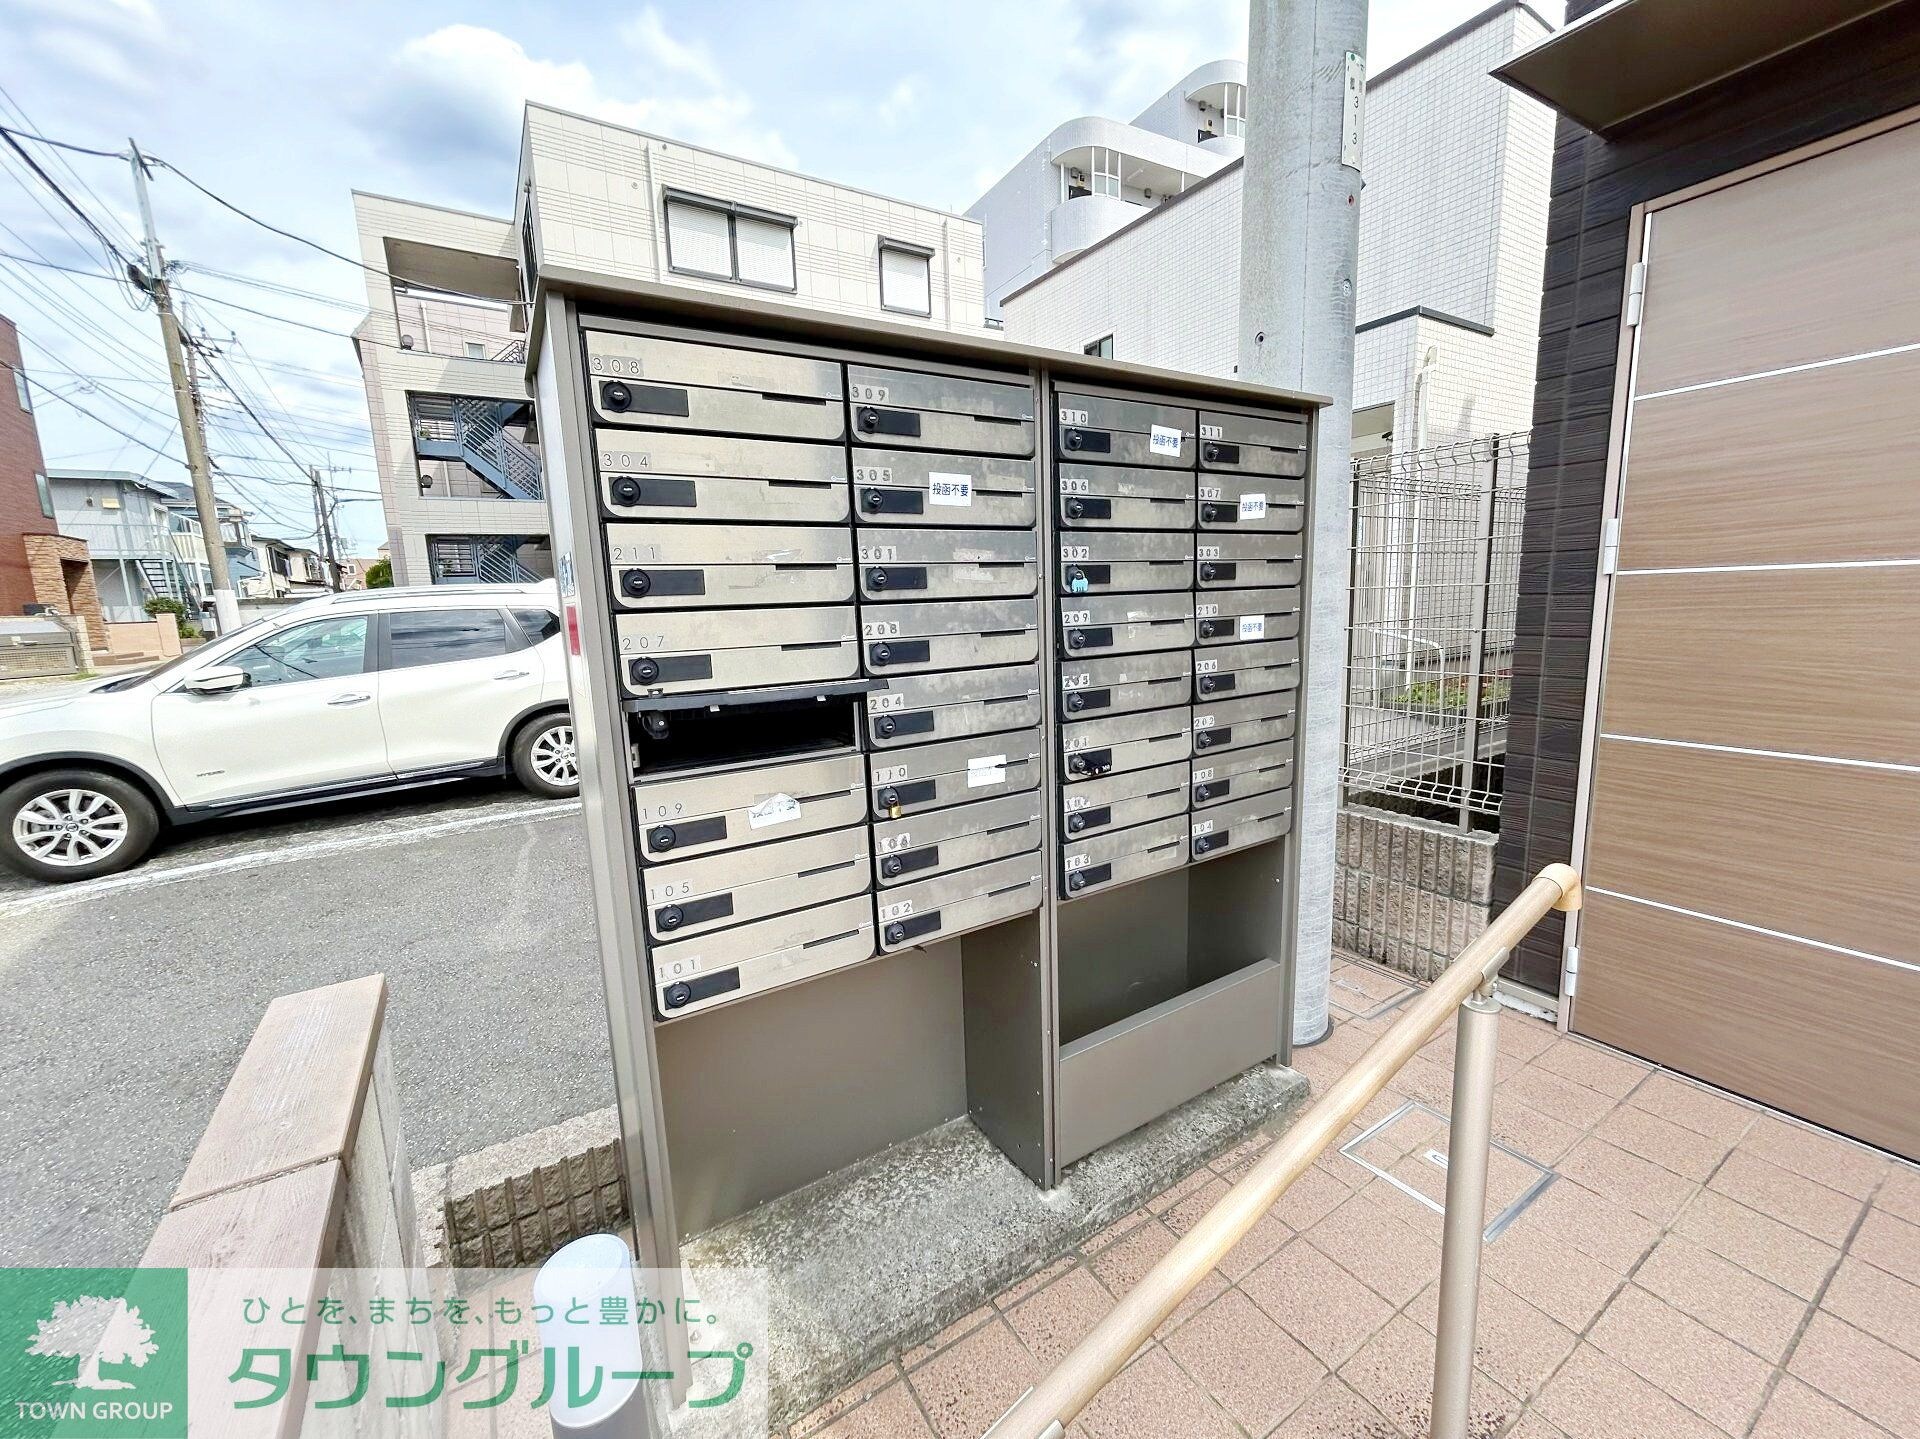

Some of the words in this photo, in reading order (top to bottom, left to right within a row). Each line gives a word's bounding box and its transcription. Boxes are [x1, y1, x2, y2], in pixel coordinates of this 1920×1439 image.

[592, 357, 639, 374] 308
[852, 386, 885, 401] 309
[1061, 411, 1087, 423] 310
[1201, 427, 1221, 437] 311
[1153, 434, 1179, 448] 投函不要
[603, 453, 649, 468] 304
[855, 469, 891, 483] 305
[932, 482, 969, 497] 投函不要
[1061, 481, 1087, 491] 306
[1201, 490, 1219, 498] 307
[1242, 502, 1264, 512] 投函不要
[613, 547, 656, 560] 211
[861, 547, 894, 560] 301
[1063, 548, 1087, 558] 302
[1199, 549, 1218, 557] 303
[1198, 606, 1217, 614] 210
[1065, 614, 1088, 622] 209
[865, 623, 897, 635] 208
[1242, 623, 1262, 632] 投函不要
[622, 635, 665, 650] 207
[1197, 662, 1216, 670] 206
[871, 697, 902, 709] 204
[1194, 718, 1214, 726] 202
[1065, 739, 1088, 748] 201
[875, 767, 906, 781] 110
[642, 803, 683, 819] 109
[1194, 823, 1212, 833] 104
[1066, 856, 1089, 867] 103
[650, 882, 689, 899] 105
[881, 903, 911, 918] 102
[658, 959, 696, 977] 101
